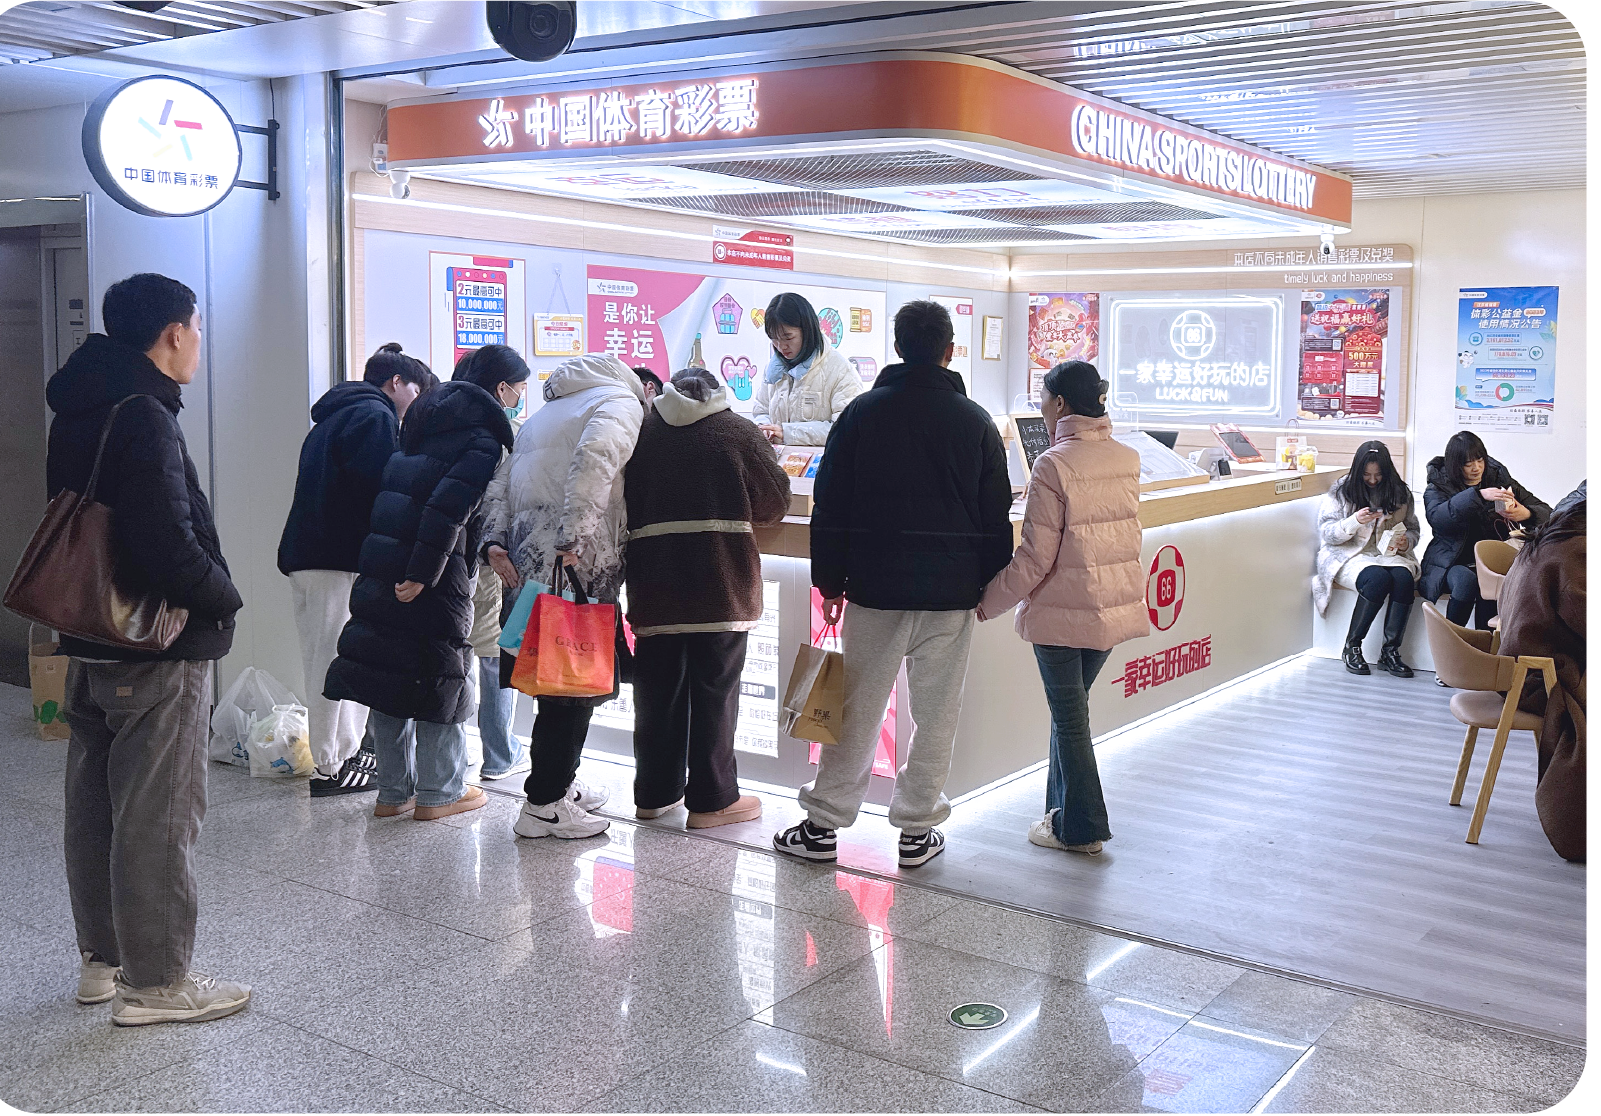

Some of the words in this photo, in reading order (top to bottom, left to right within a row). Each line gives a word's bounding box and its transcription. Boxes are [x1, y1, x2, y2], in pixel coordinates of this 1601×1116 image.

[525, 78, 760, 147] 中国体育彩票
[1071, 104, 1153, 169] CHINA
[1153, 130, 1239, 193] SPORTS
[1240, 152, 1316, 210] LOTTERY
[124, 167, 219, 190] 中国体育彩票
[1284, 272, 1309, 284] timely
[1311, 272, 1328, 283] luck
[1332, 272, 1347, 283] and
[1350, 271, 1394, 283] happiness
[457, 283, 503, 297] 2元最高可中
[457, 298, 504, 311] 10,000,000元
[603, 301, 656, 325] 是你让
[1310, 312, 1374, 325] 送祝福赢好礼
[457, 315, 503, 330] 3元最高可中
[1478, 319, 1542, 329] 使用情况公告
[603, 327, 655, 359] 幸运
[1186, 327, 1201, 343] 66
[1348, 352, 1379, 361] 500万元
[1118, 359, 1271, 387] 一家幸运好玩的店
[1155, 386, 1228, 402] LUCK&FUN
[1161, 575, 1172, 601] 66
[1111, 633, 1212, 698] 一家幸运好玩的店
